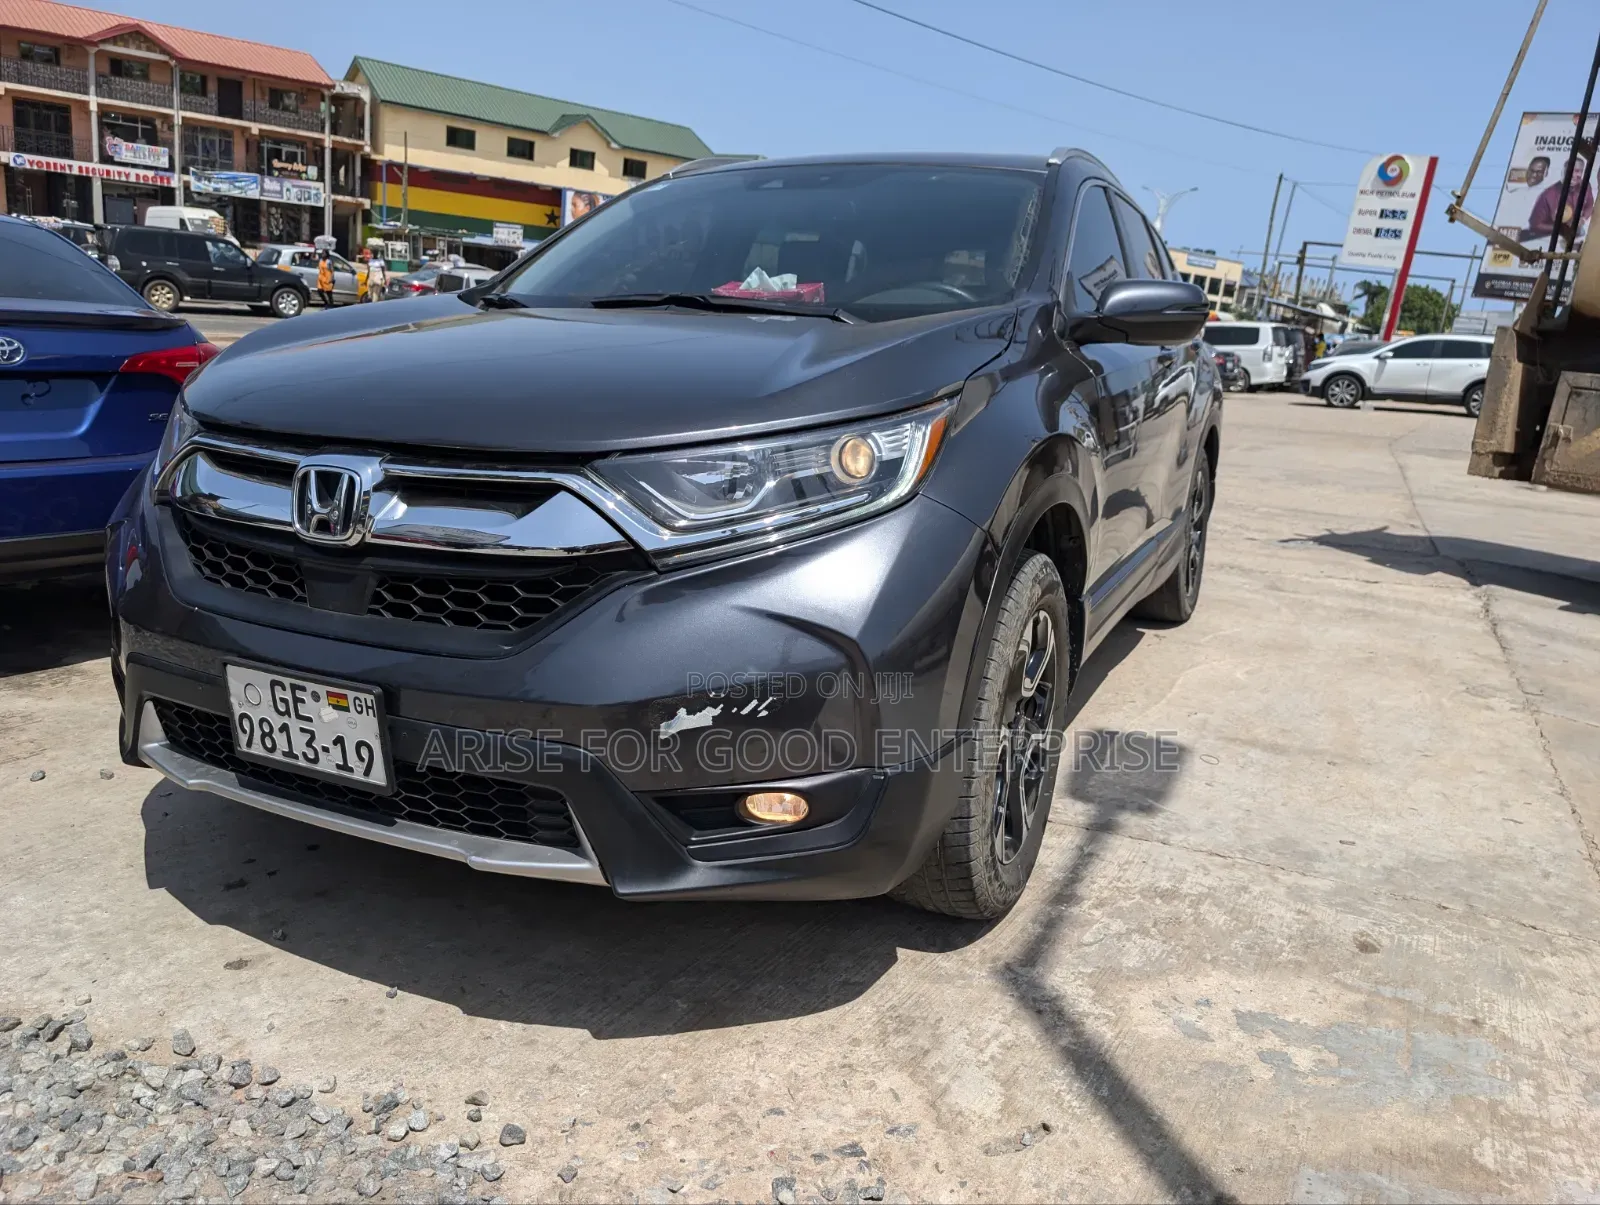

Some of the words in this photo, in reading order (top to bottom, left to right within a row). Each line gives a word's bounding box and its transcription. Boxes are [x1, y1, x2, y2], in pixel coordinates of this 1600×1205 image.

[77, 165, 131, 181] SECURITY
[135, 172, 172, 186] DOORS
[269, 679, 314, 723] GE
[352, 695, 377, 718] GH
[238, 711, 375, 777] 9813-19
